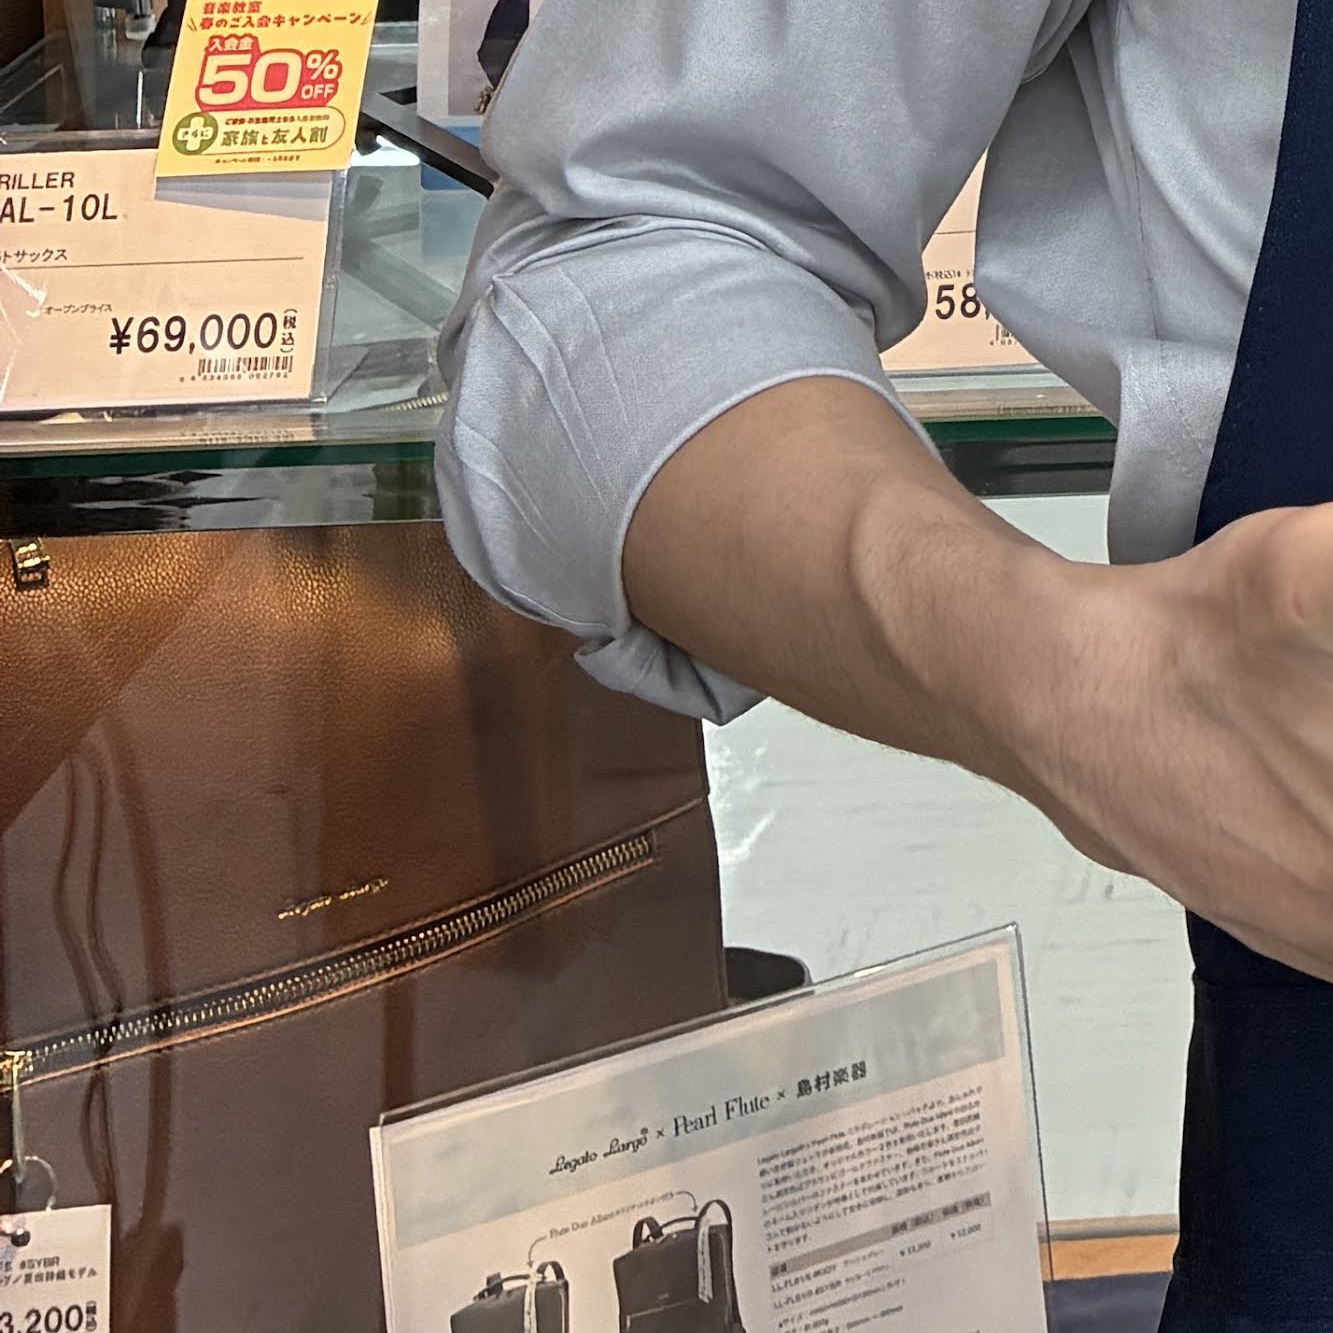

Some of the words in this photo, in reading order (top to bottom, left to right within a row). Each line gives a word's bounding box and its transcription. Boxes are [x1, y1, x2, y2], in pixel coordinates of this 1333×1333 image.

[208, 37, 253, 52] 入会金
[301, 84, 335, 100] OFF
[0, 172, 75, 190] RILLER
[0, 193, 118, 223] AL-10L
[0, 249, 67, 263] トサックス
[109, 312, 278, 355] ¥69,000
[672, 1105, 718, 1137] Pearl
[724, 1096, 770, 1121] Flute
[796, 1060, 867, 1098] 島村楽器
